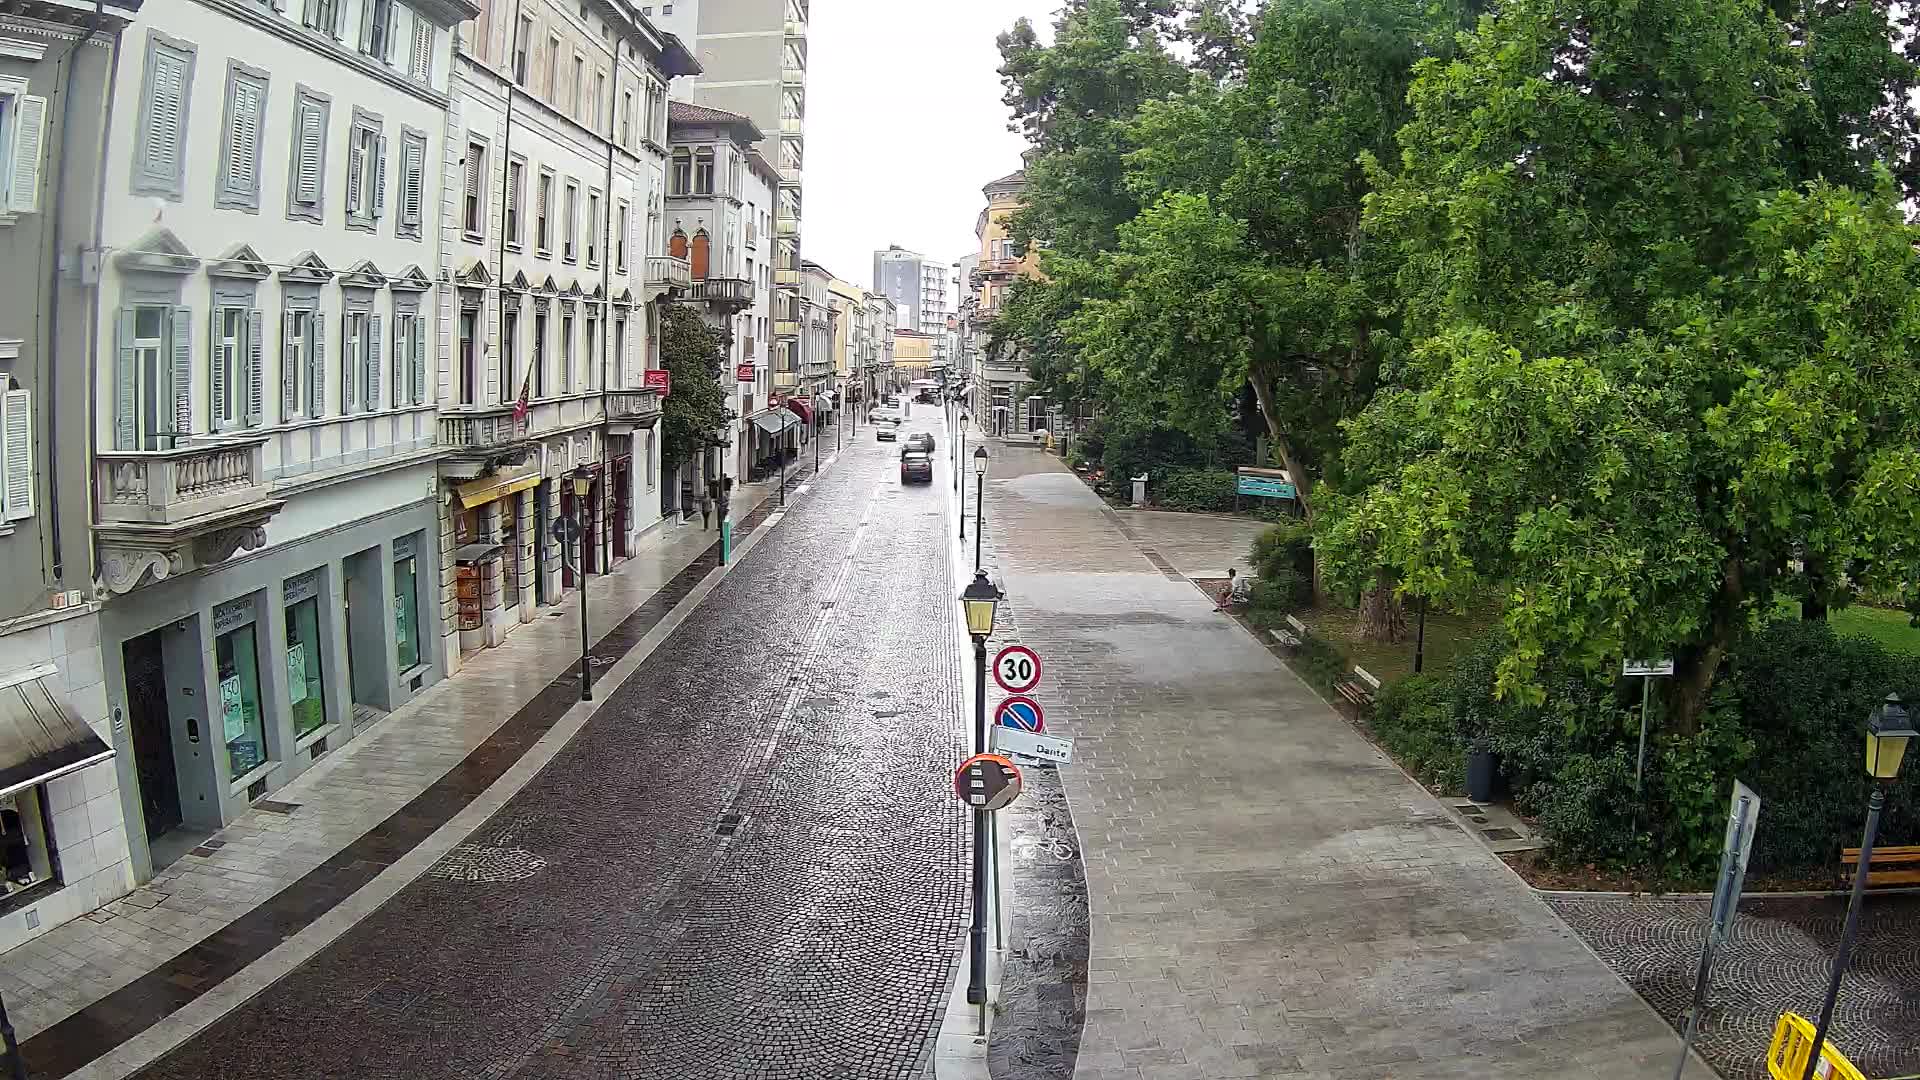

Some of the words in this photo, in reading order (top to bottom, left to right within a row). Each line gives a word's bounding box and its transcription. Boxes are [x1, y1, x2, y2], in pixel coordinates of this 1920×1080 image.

[1003, 658, 1031, 680] 30
[221, 678, 239, 702] 130
[1036, 744, 1067, 758] Dante
